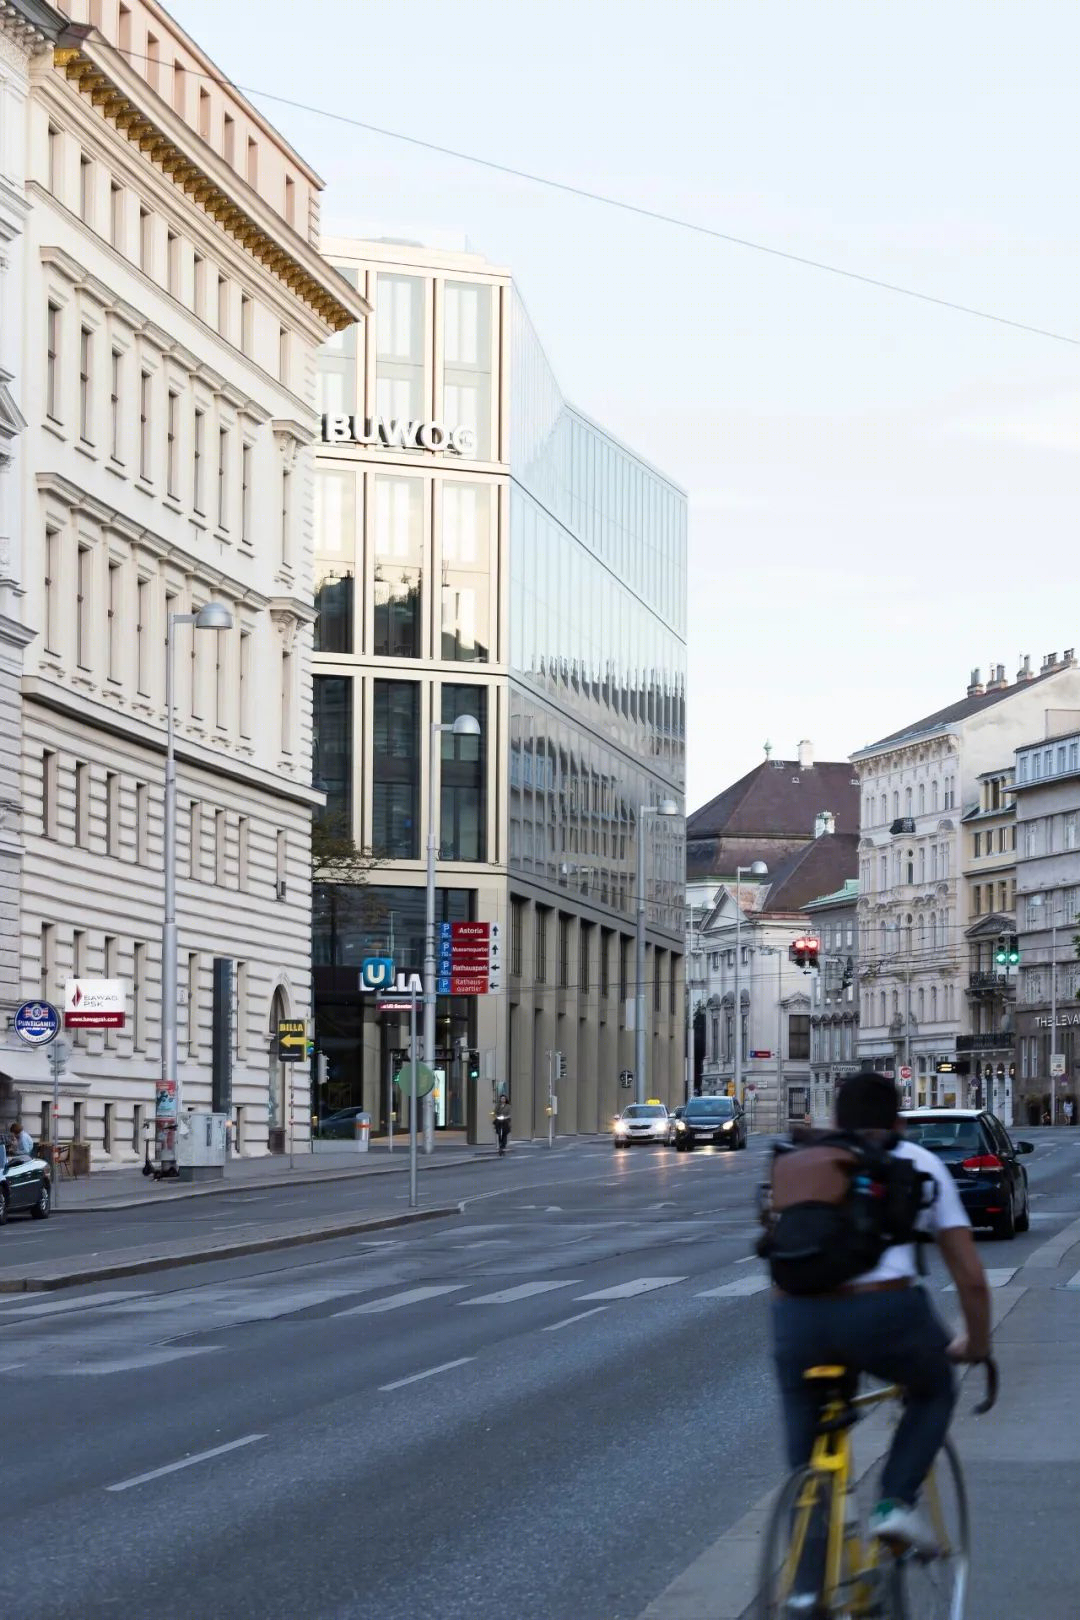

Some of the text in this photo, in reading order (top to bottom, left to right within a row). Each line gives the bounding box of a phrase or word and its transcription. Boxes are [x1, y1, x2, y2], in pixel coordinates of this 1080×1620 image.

[322, 413, 477, 453] BUWOG
[367, 964, 385, 984] U
[279, 1023, 304, 1032] BILLA
[1034, 1014, 1080, 1027] THE LEVA
